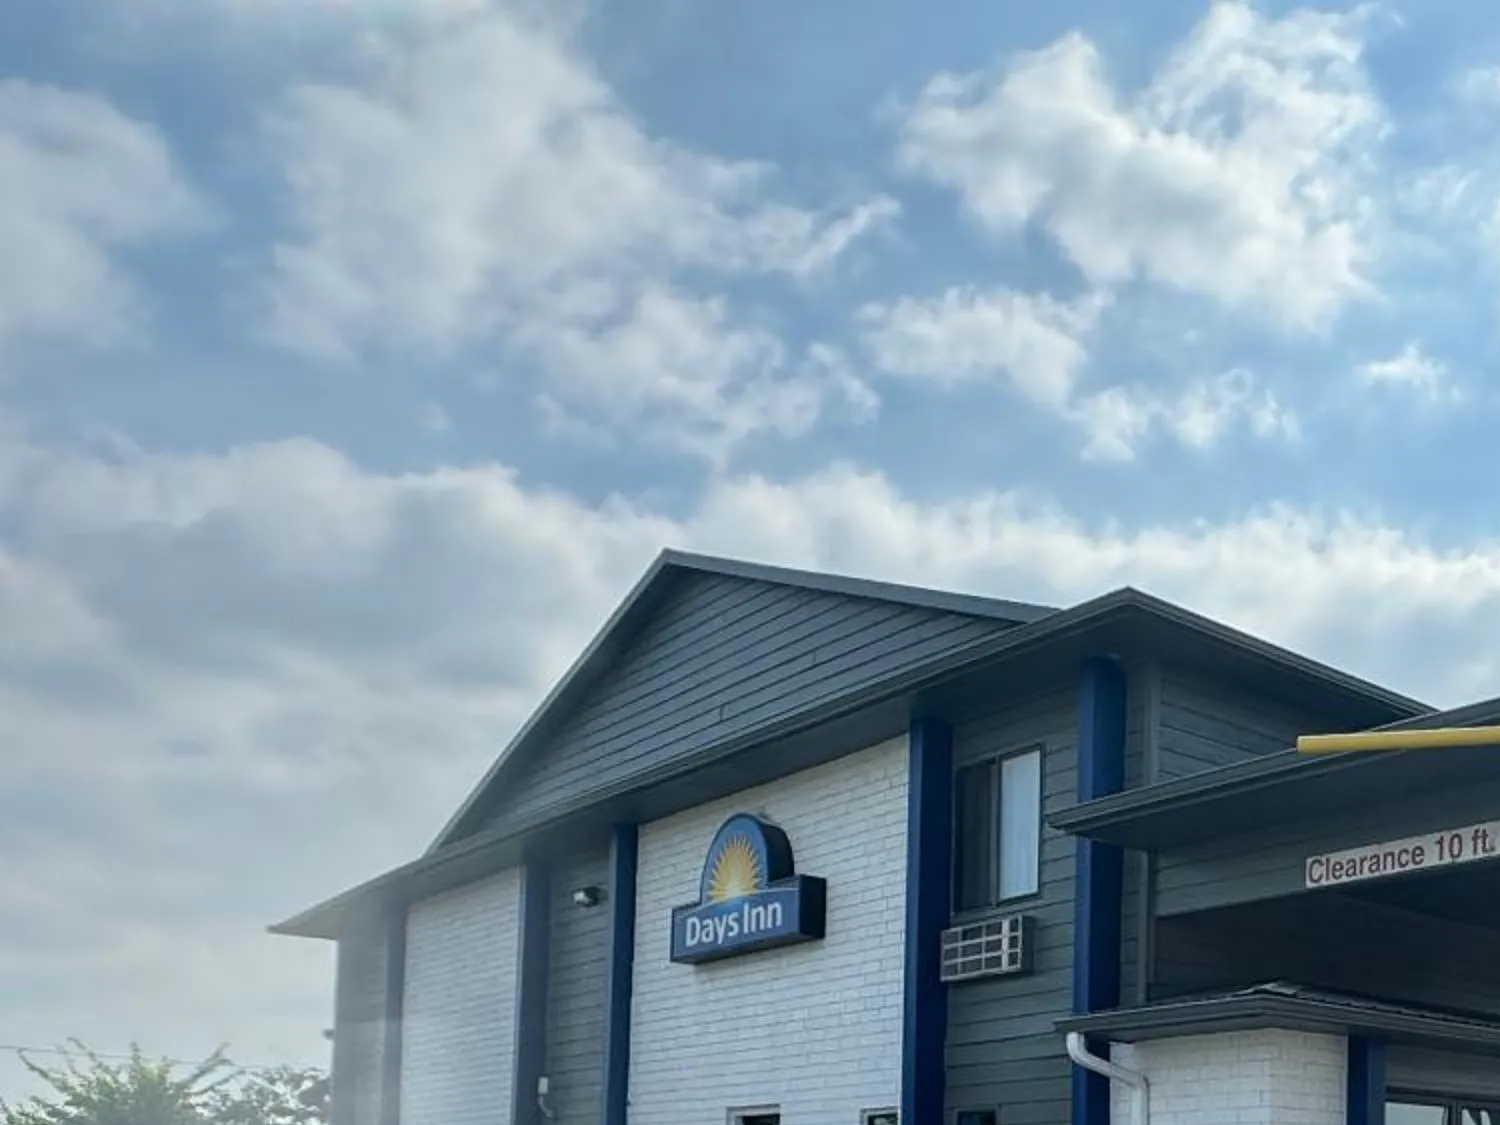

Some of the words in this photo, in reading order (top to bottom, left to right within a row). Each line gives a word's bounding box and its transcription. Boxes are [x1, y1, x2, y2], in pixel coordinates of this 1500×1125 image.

[1308, 845, 1425, 884] Clearance
[1434, 833, 1464, 861] 10
[1471, 827, 1496, 854] ft.
[685, 911, 739, 947] Days
[743, 901, 783, 934] Inn
